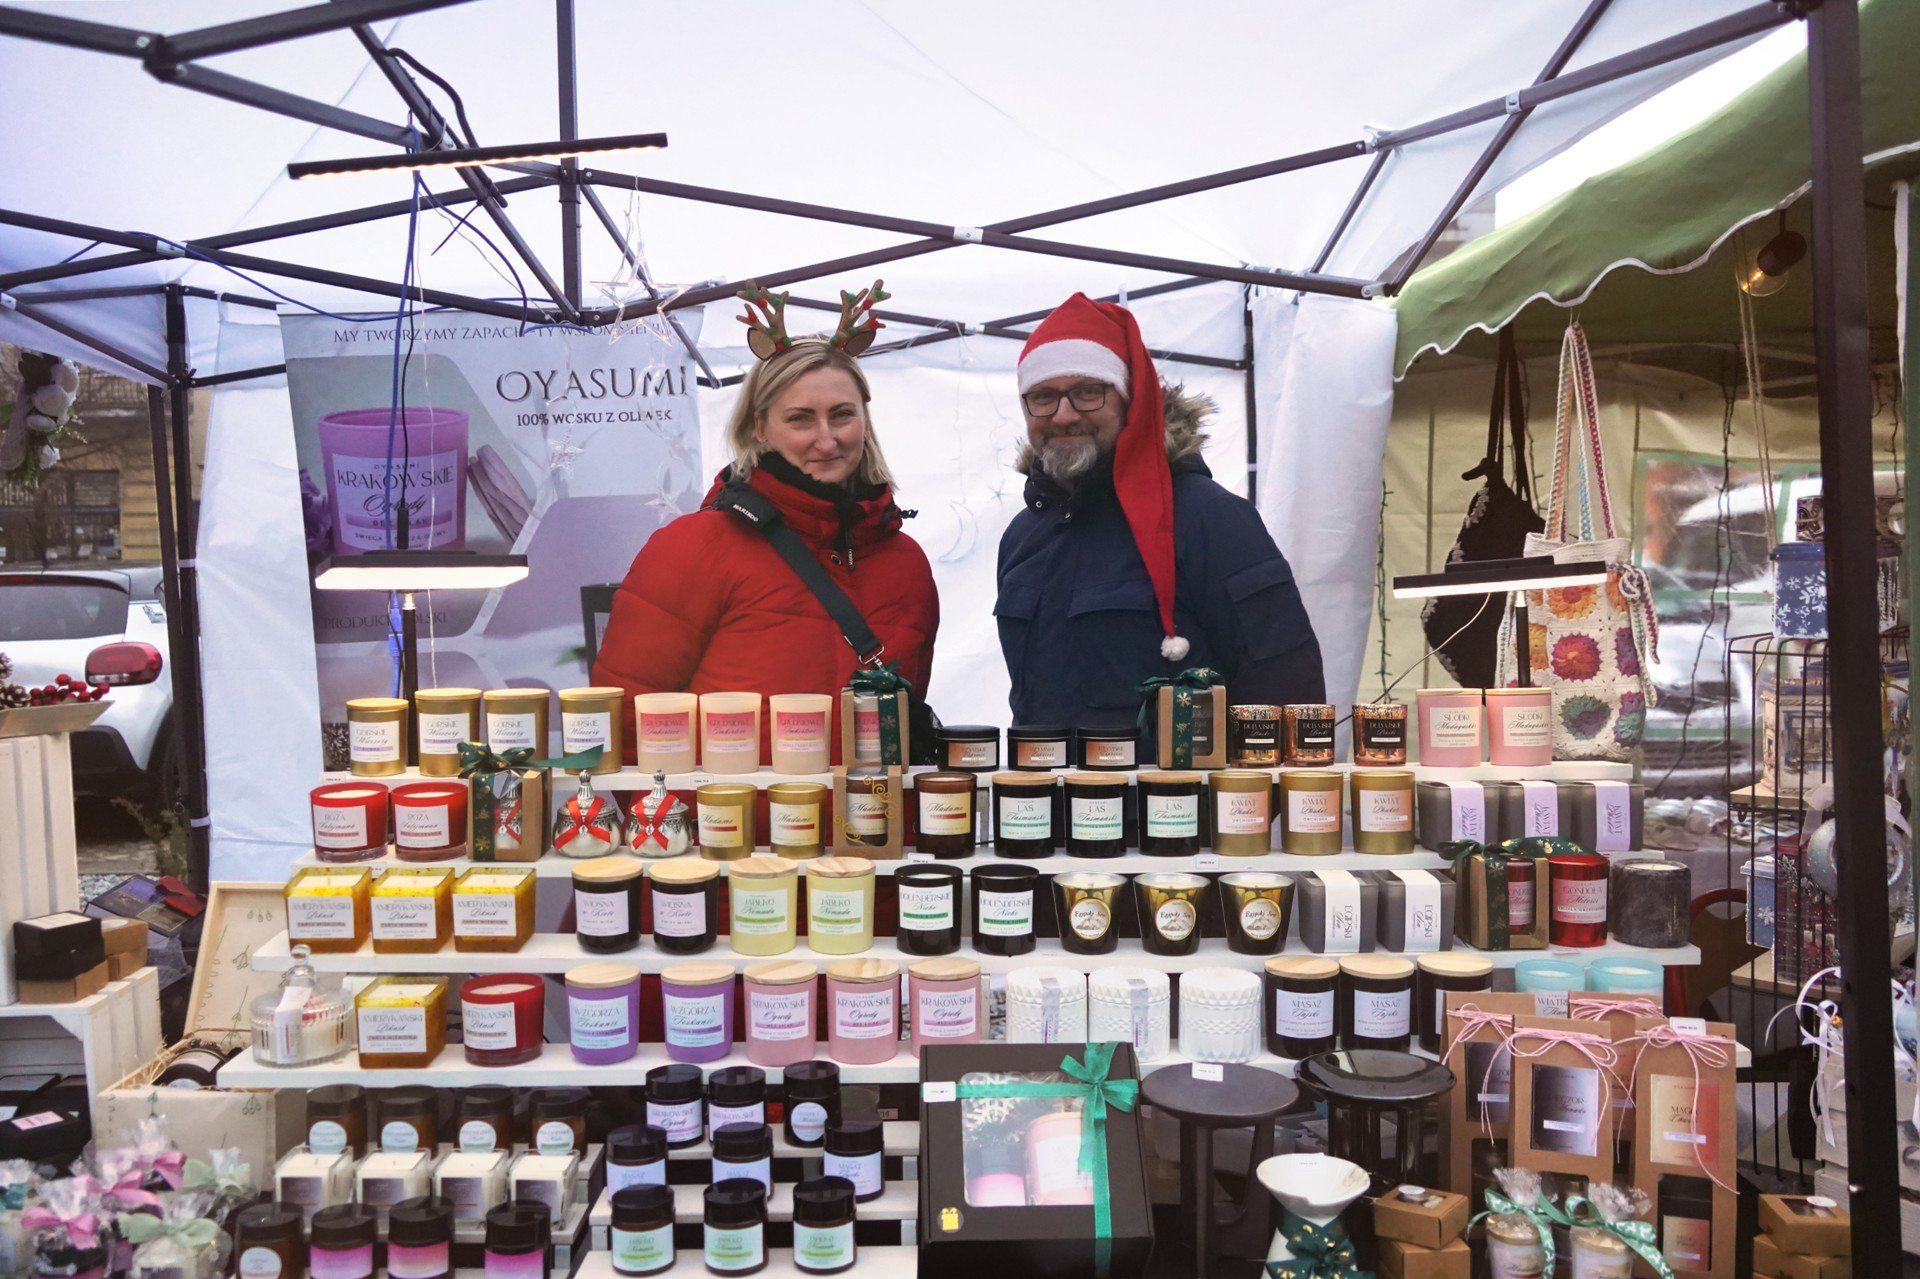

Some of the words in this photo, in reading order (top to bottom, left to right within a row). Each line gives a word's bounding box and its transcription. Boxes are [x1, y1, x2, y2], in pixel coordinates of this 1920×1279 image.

[334, 329, 358, 342] MY
[496, 366, 688, 402] OYASUMI
[517, 413, 549, 427] 100%
[606, 412, 616, 423] Z
[322, 615, 390, 629] PRODUK
